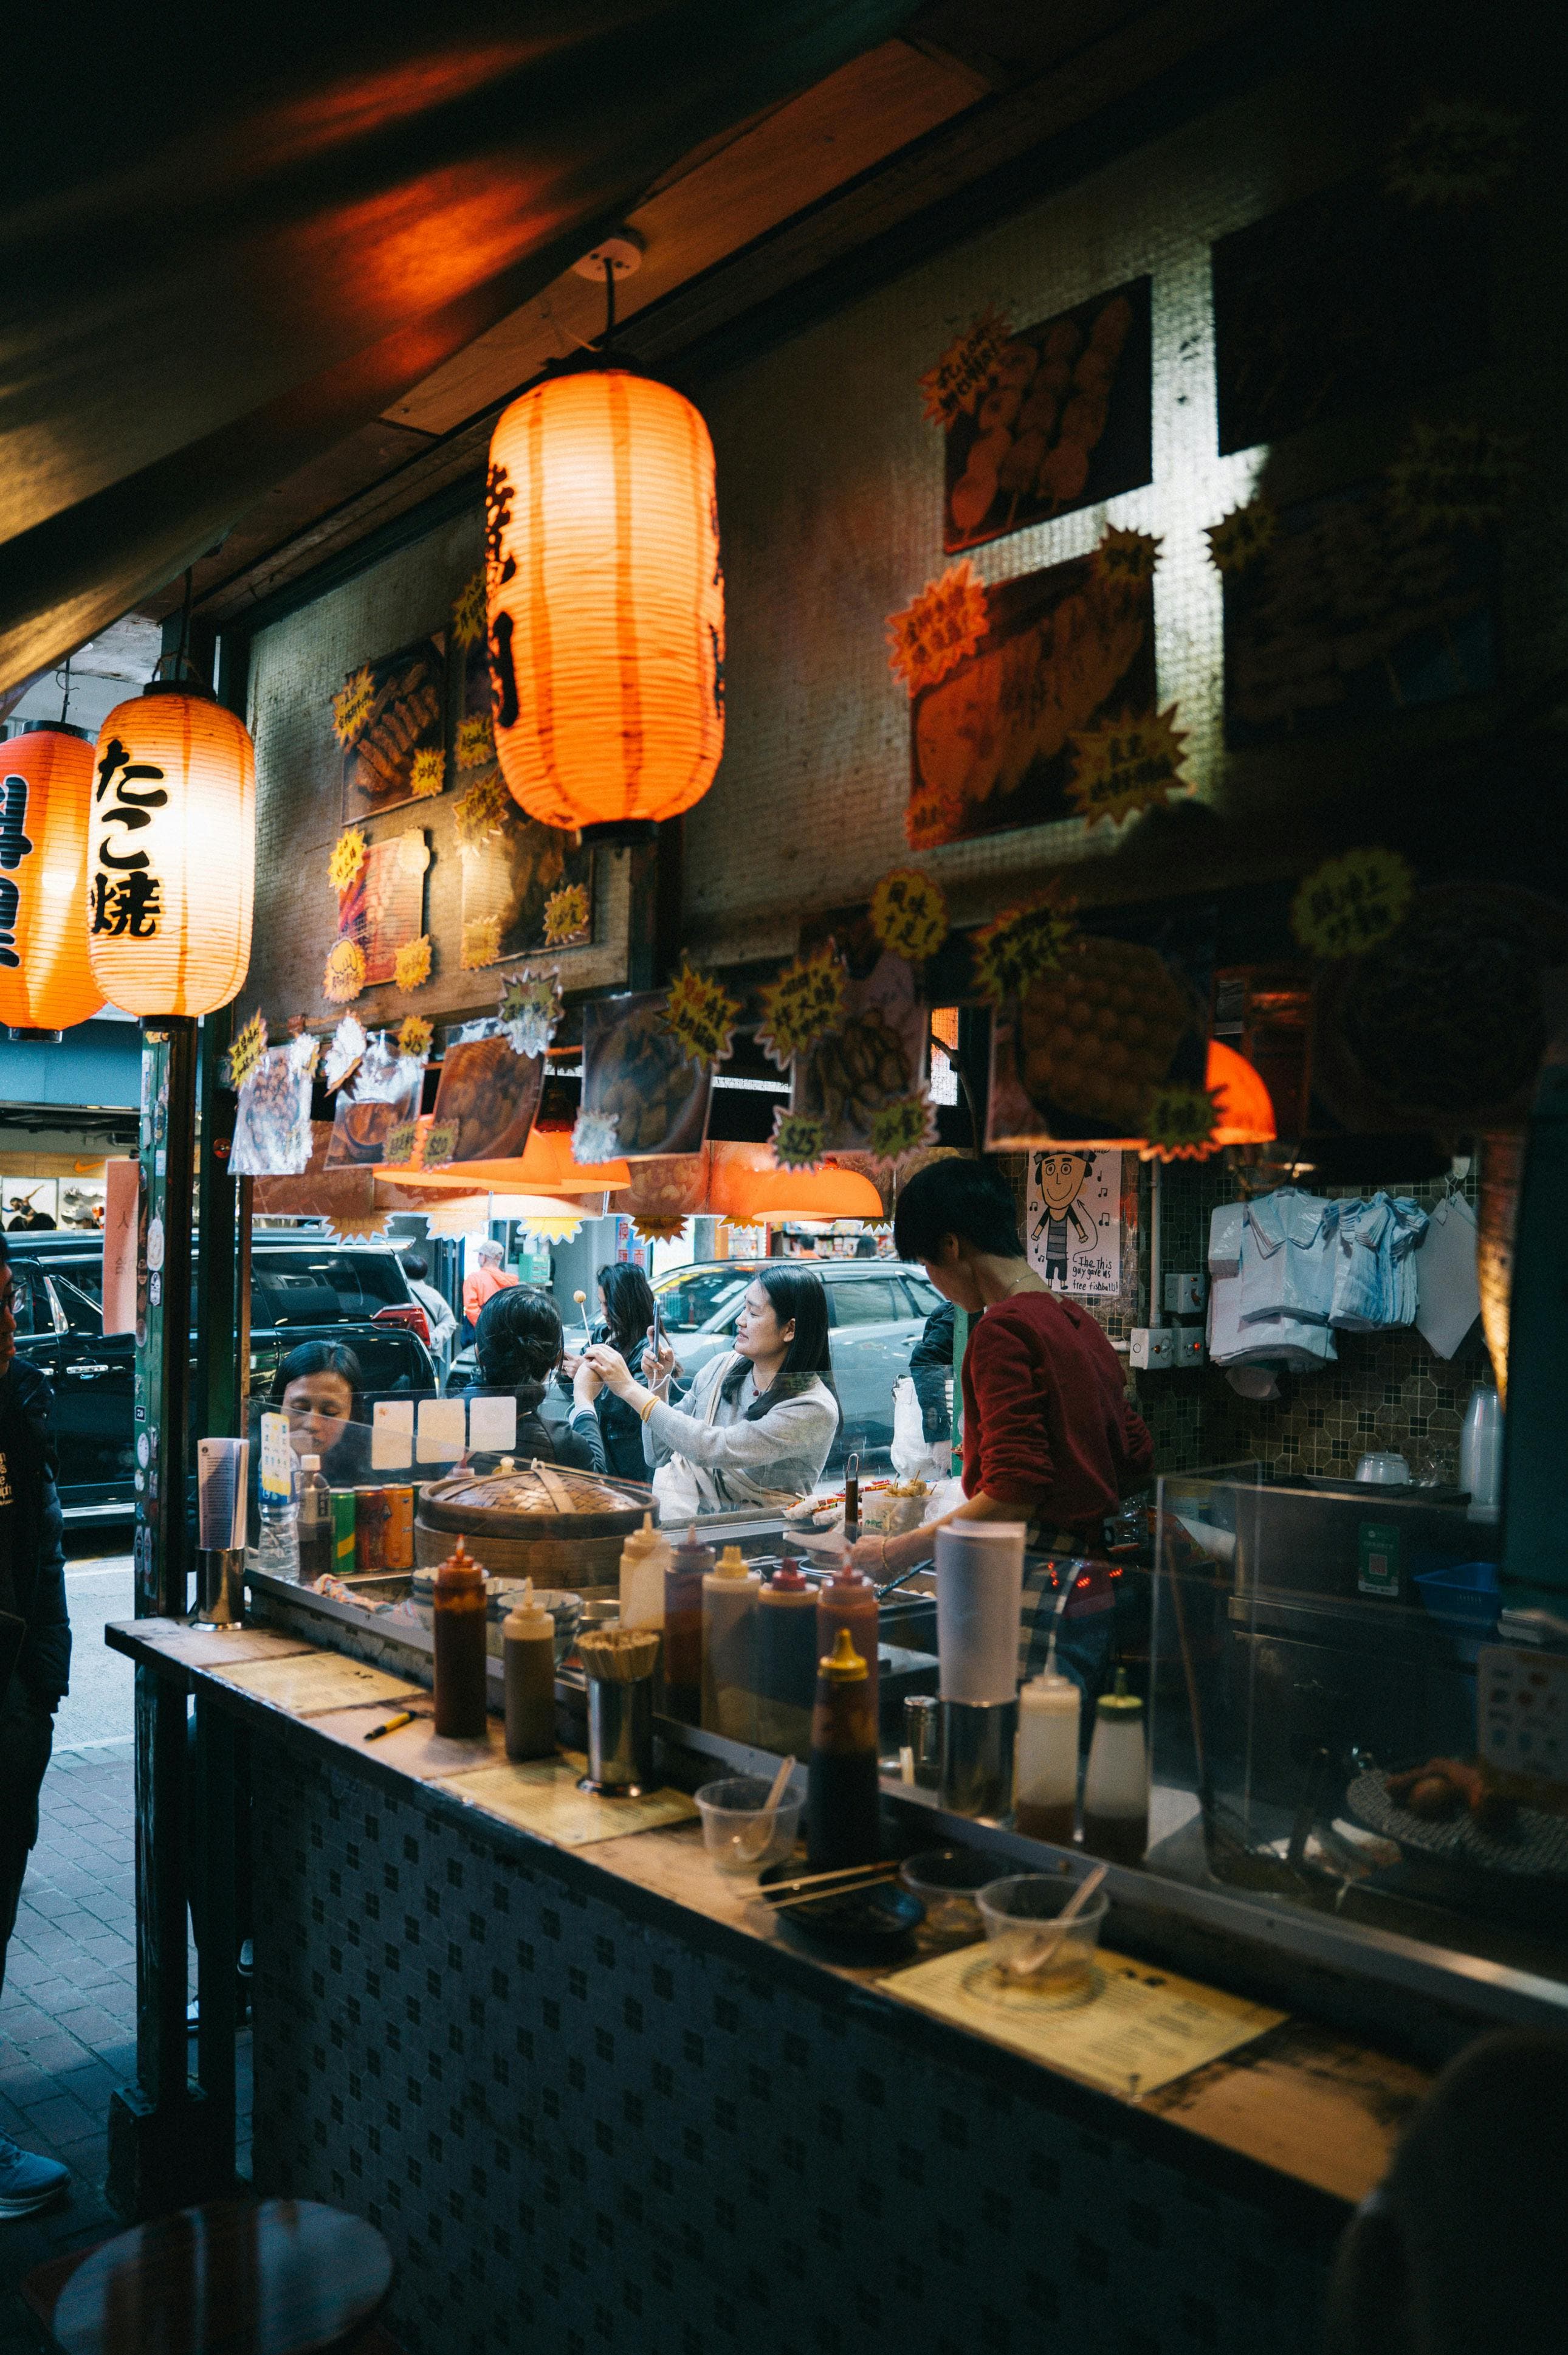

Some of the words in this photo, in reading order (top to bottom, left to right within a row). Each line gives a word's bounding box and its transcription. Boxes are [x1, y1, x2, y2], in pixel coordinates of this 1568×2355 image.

[91, 739, 168, 937] たこ焼
[1096, 1257, 1112, 1269] This
[1072, 1266, 1086, 1279] guy
[1087, 1269, 1101, 1280] gave
[1103, 1270, 1111, 1278] us
[1073, 1279, 1086, 1291] free
[1089, 1281, 1118, 1292] fishballs!
